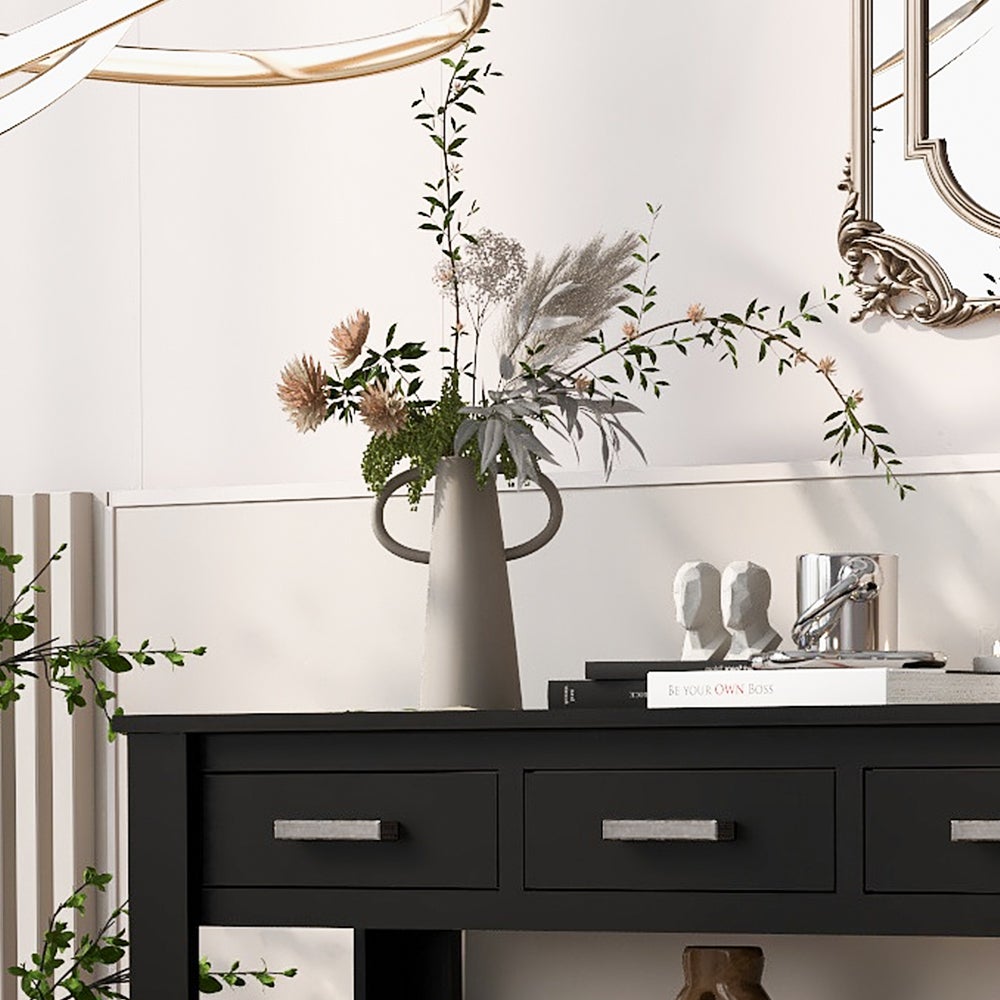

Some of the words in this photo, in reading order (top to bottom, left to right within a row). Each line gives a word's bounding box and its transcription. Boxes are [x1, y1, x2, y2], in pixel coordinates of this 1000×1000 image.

[668, 684, 680, 697] BE
[683, 684, 712, 697] YOUR
[714, 683, 745, 696] OWN
